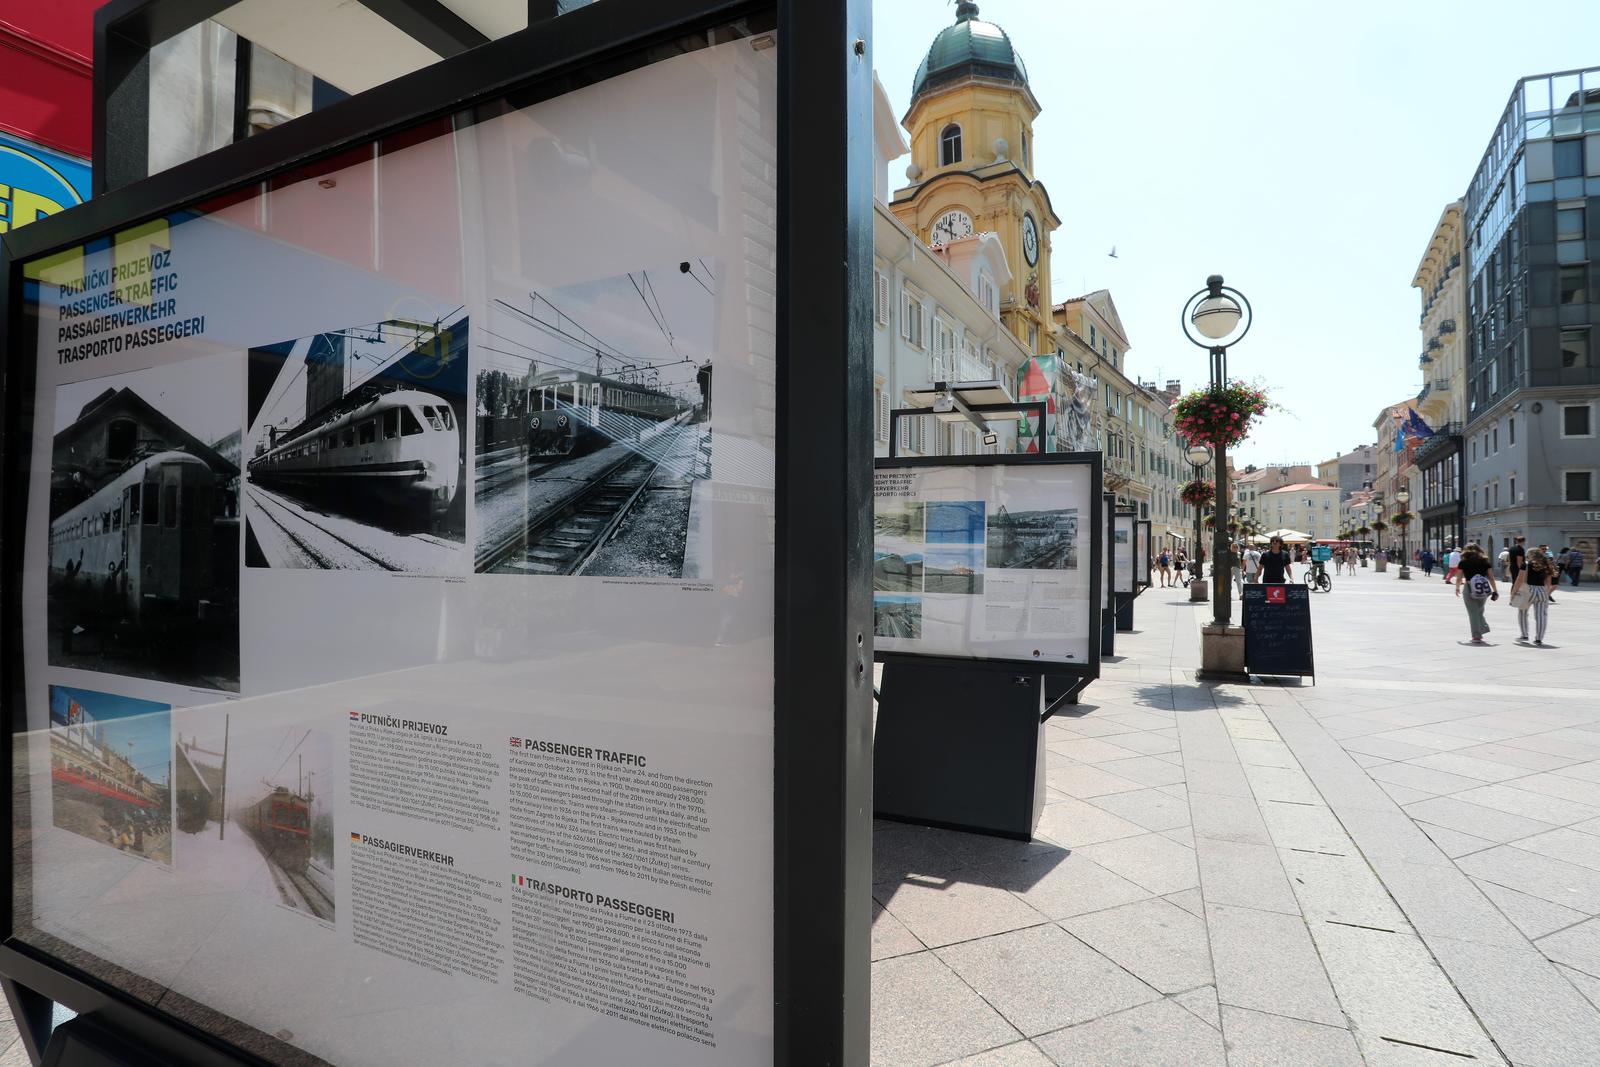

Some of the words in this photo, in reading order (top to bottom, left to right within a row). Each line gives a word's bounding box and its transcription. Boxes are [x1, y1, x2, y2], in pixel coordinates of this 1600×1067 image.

[966, 225, 971, 234] 3
[60, 269, 109, 299] PUTNIČKI
[112, 250, 171, 283] PRIJEVOZ
[59, 290, 122, 321] PASSENGER
[125, 273, 177, 302] TRAFFIC
[58, 298, 176, 343] PASSAGIERVERKEHR
[57, 336, 122, 365] TRASPORTO
[125, 316, 205, 351] PASSEGGERI
[1475, 582, 1491, 594] 99
[361, 713, 400, 728] PUTNIČKI
[402, 720, 448, 735] PRIJEVOZ
[525, 739, 592, 759] PASSENGER
[595, 749, 646, 767] TRAFFIC
[362, 835, 454, 866] PASSAGIERVERKEHR
[526, 877, 594, 904] TRASPORTO
[596, 894, 675, 923] PASSEGGERI
